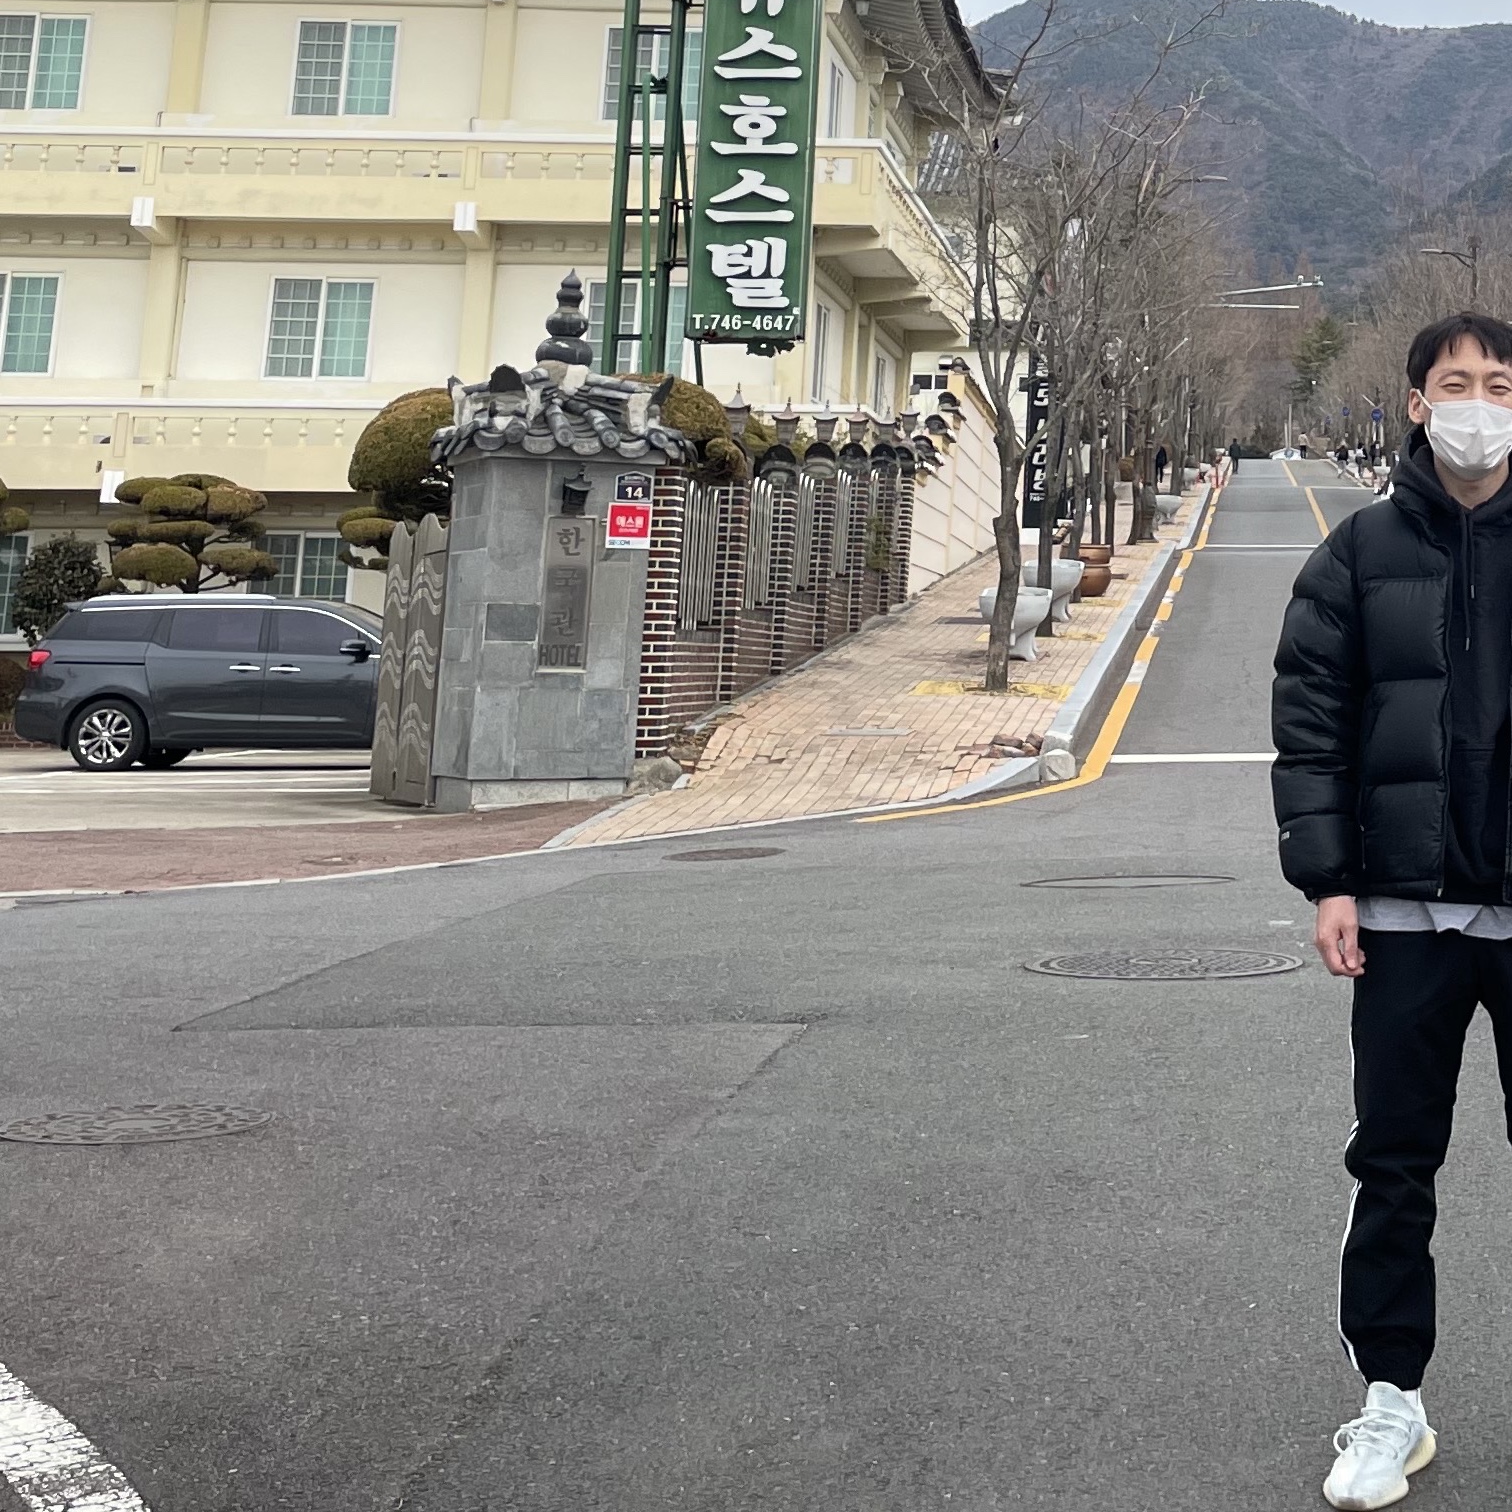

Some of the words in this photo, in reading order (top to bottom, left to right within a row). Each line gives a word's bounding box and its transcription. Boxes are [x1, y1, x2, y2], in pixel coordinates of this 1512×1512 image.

[692, 314, 795, 330] T.746-4647
[625, 486, 644, 498] 14
[539, 643, 583, 667] HOTEL
